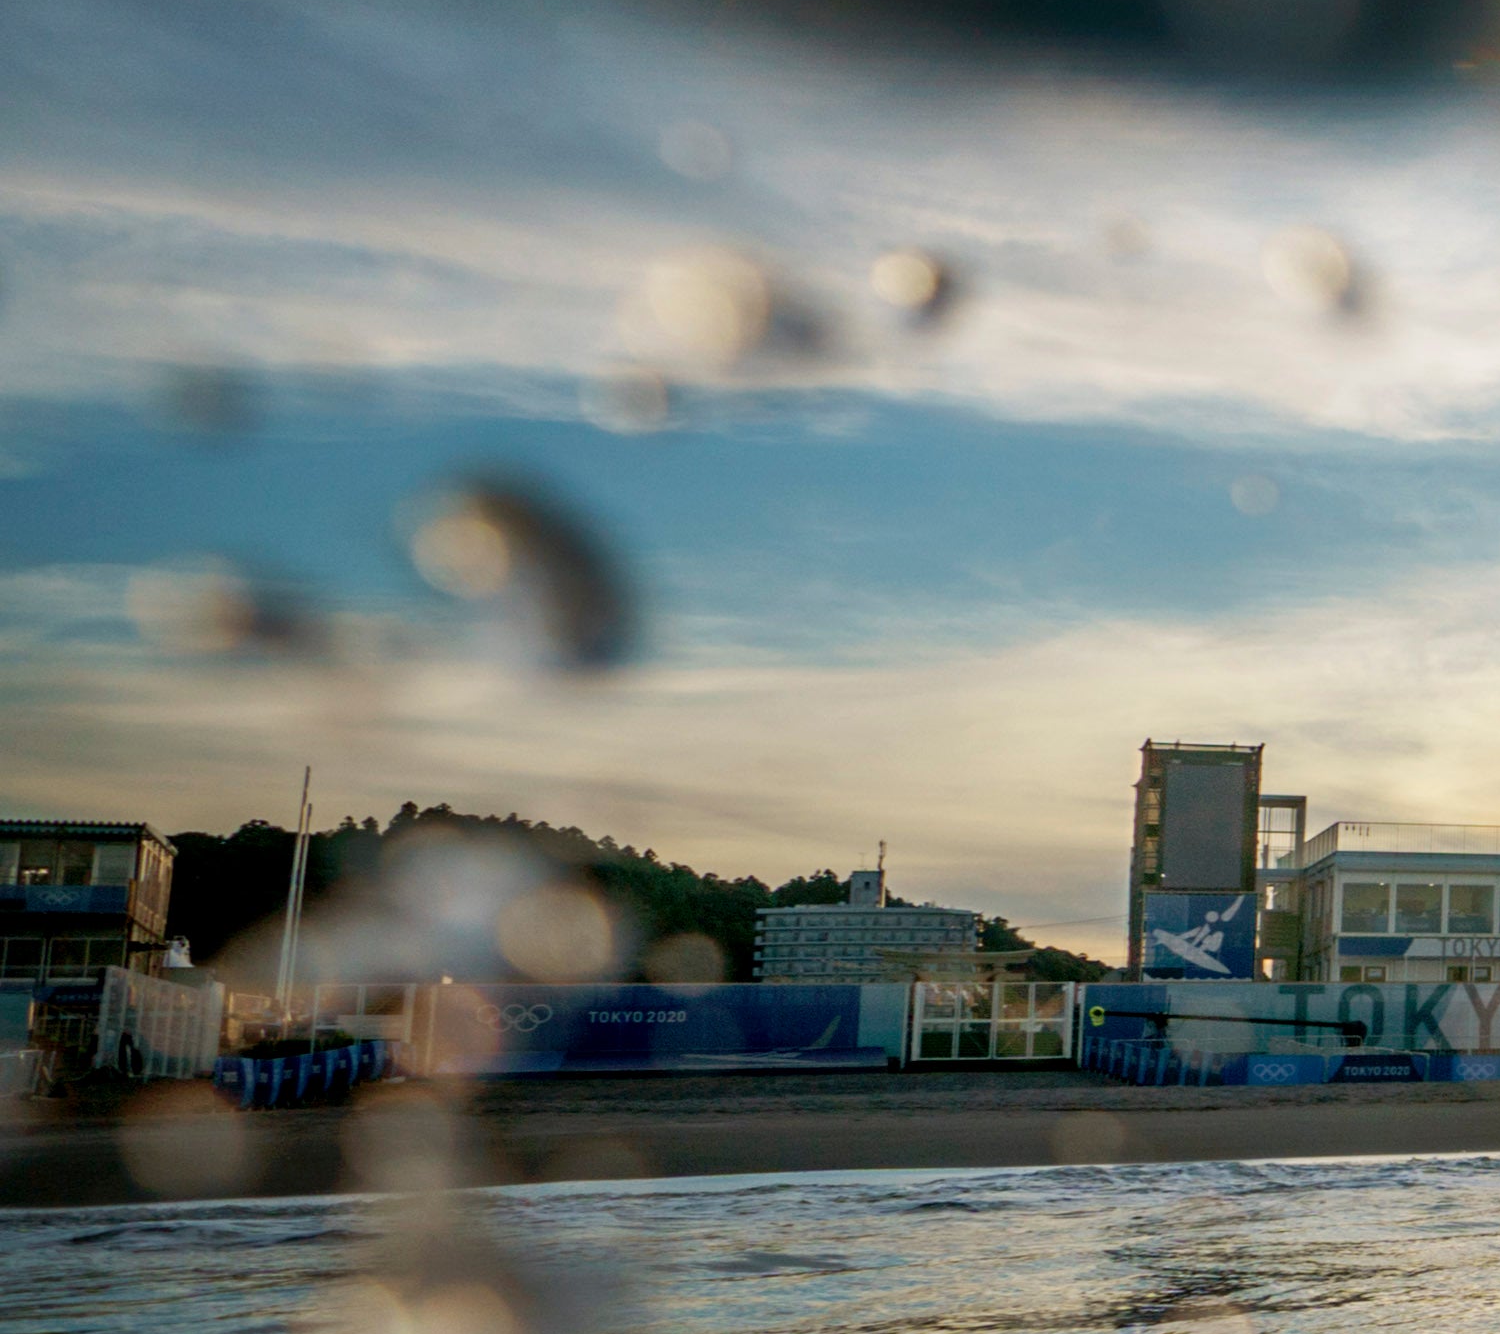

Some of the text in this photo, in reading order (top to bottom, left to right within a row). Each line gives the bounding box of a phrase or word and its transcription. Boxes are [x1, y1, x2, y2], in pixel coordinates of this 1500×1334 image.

[589, 1011, 687, 1023] TOKYO 2020
[1344, 1066, 1411, 1076] TOKYO 2020
